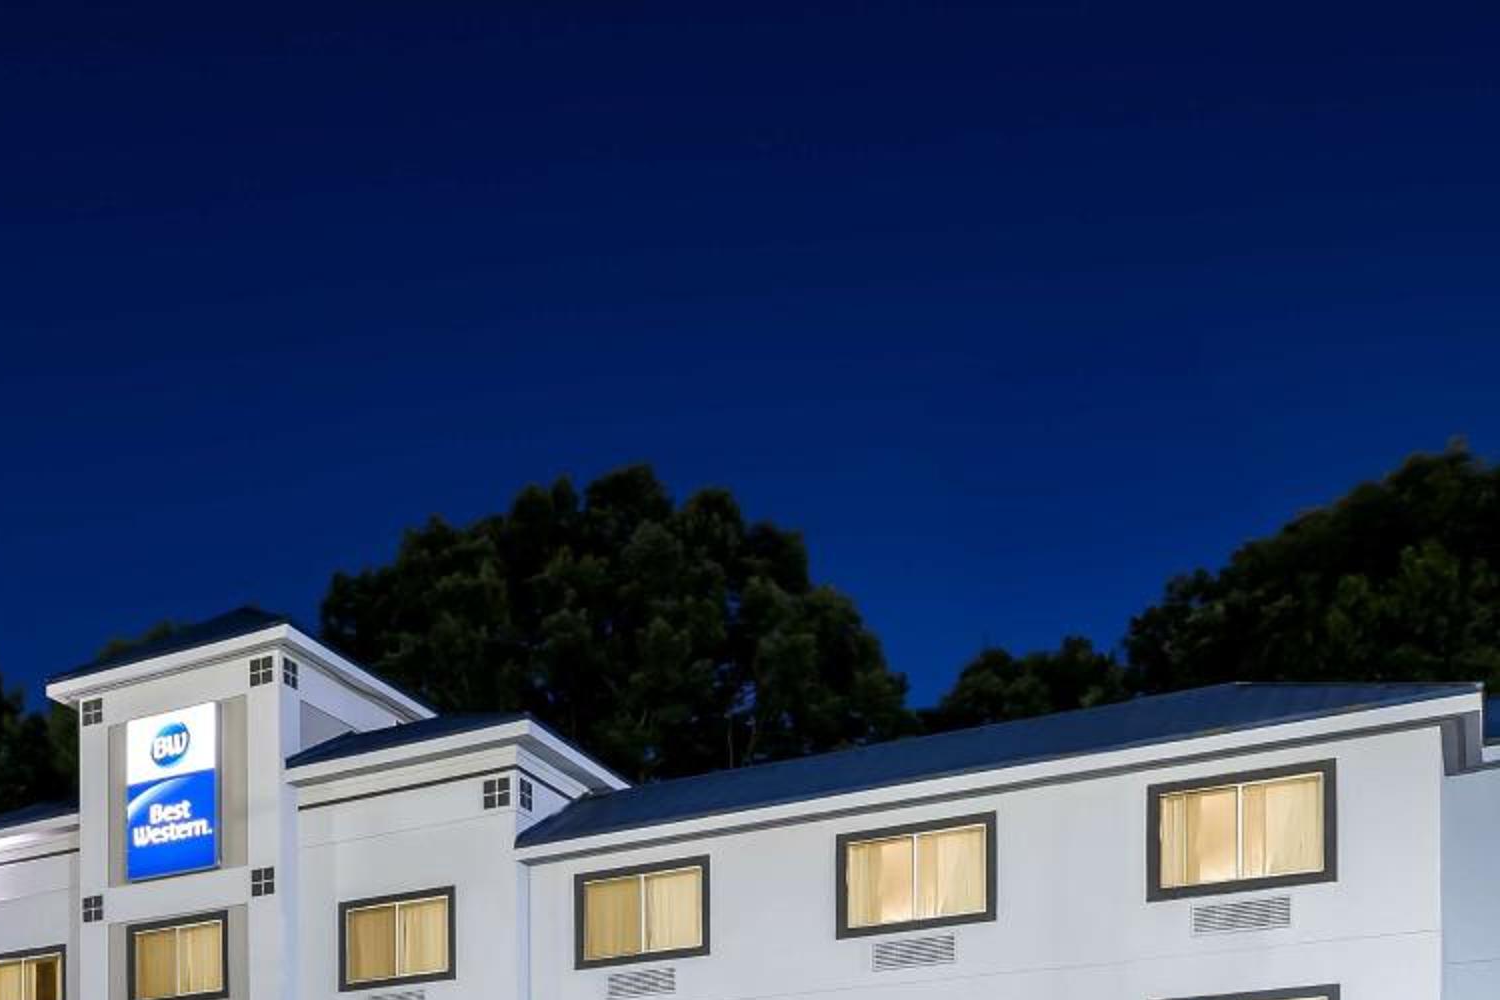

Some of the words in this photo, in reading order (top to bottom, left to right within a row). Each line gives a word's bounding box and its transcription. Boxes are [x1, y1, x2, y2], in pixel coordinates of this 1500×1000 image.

[153, 731, 188, 760] BW
[150, 800, 191, 825] Best
[132, 819, 213, 847] Western.
